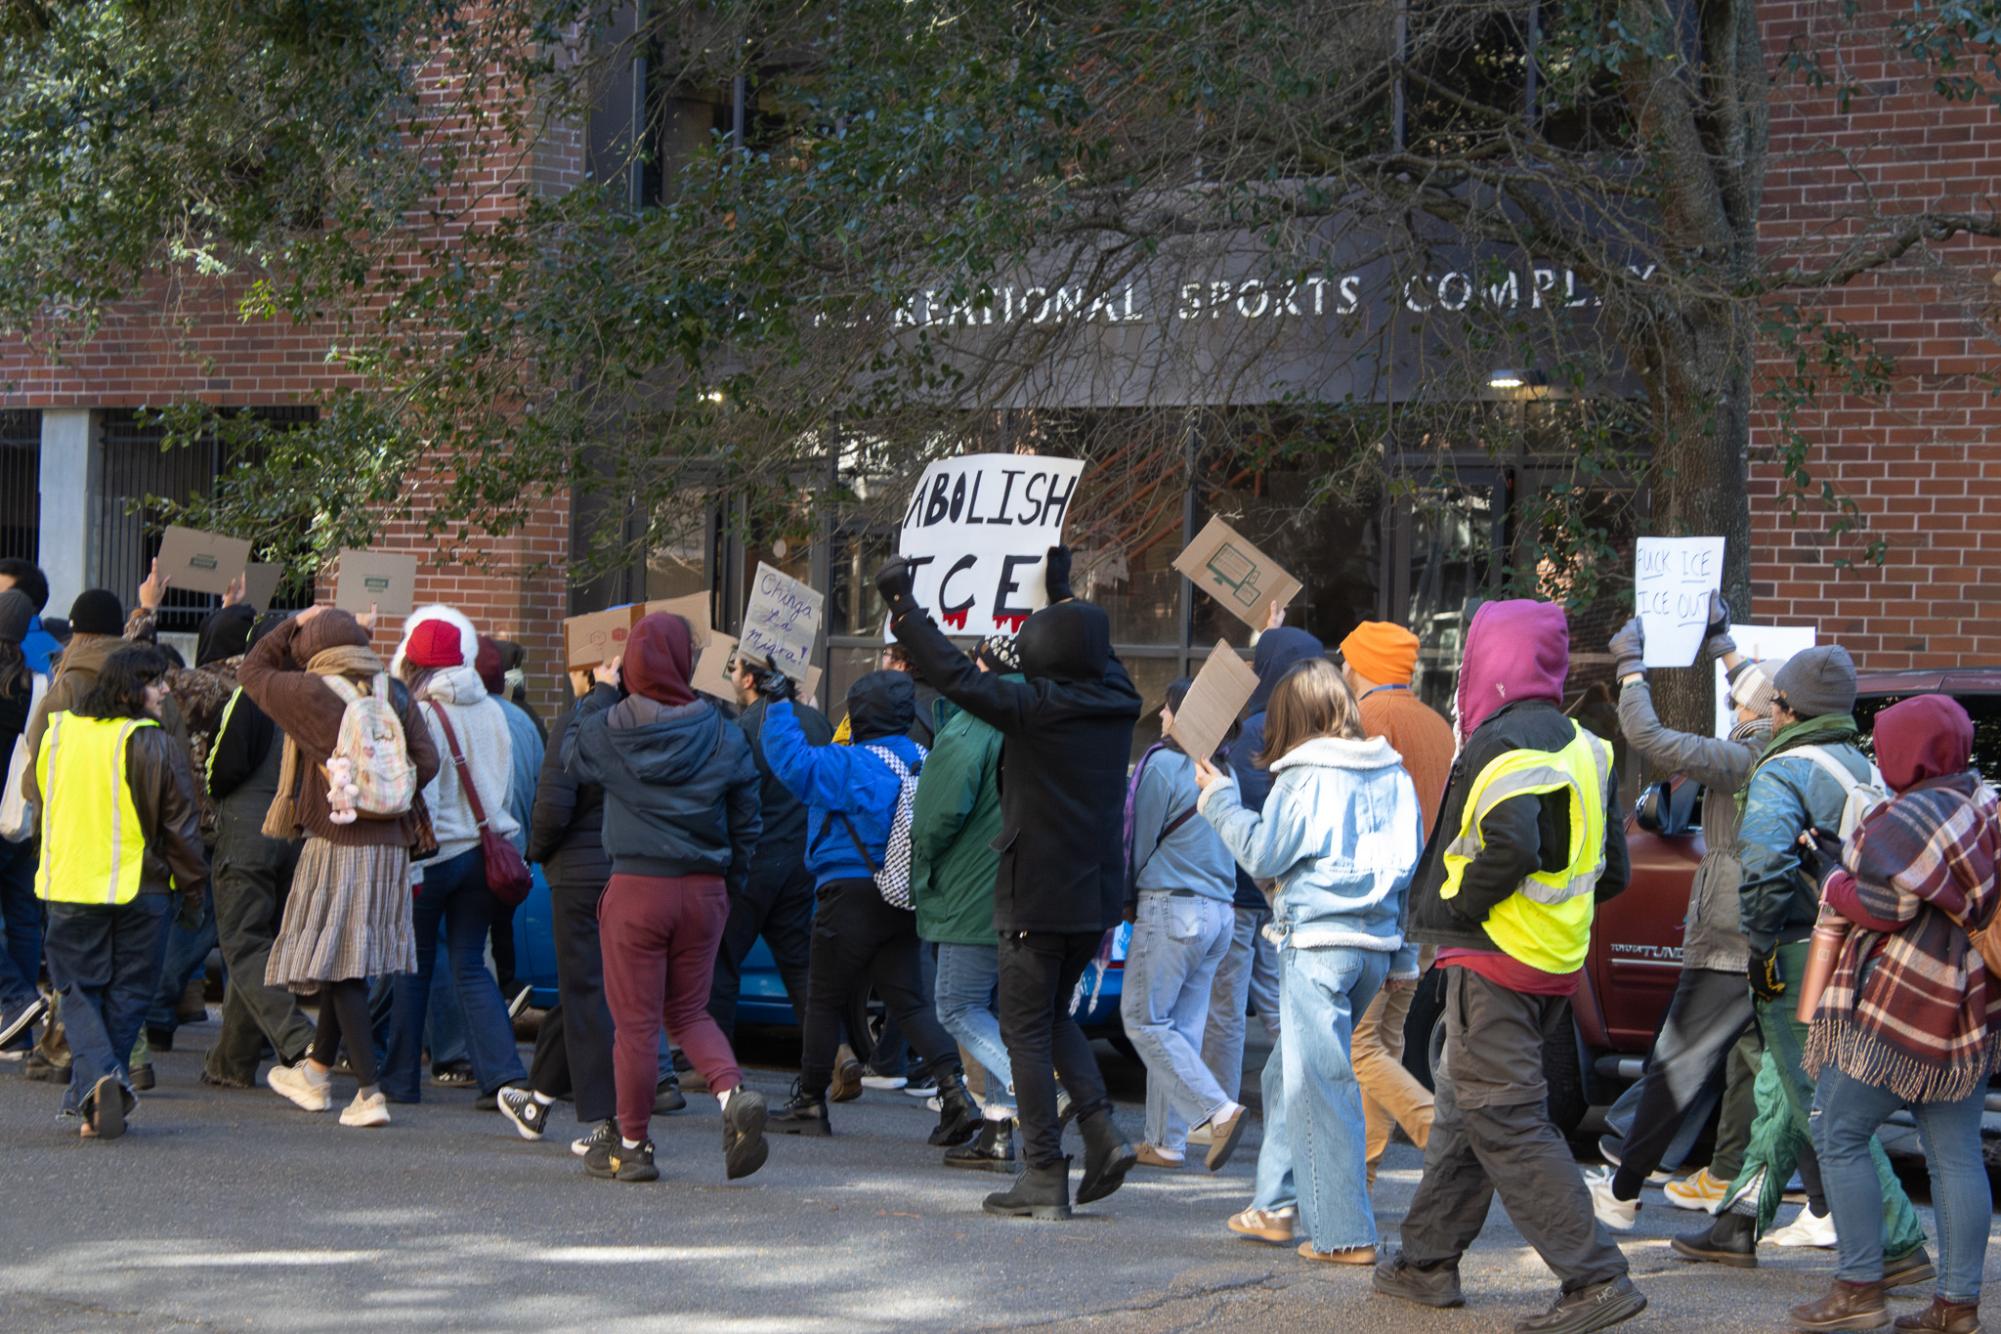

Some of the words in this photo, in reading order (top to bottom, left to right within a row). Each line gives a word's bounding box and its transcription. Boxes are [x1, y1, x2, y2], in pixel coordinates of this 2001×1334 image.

[1179, 275, 1361, 319] SPORTS
[1405, 264, 1656, 313] COMPL
[903, 469, 1077, 529] ABOLISH
[1680, 550, 1712, 577] ICE
[1637, 591, 1670, 616] ICE
[1678, 591, 1710, 619] OUT
[1596, 1286, 1620, 1304] HO
